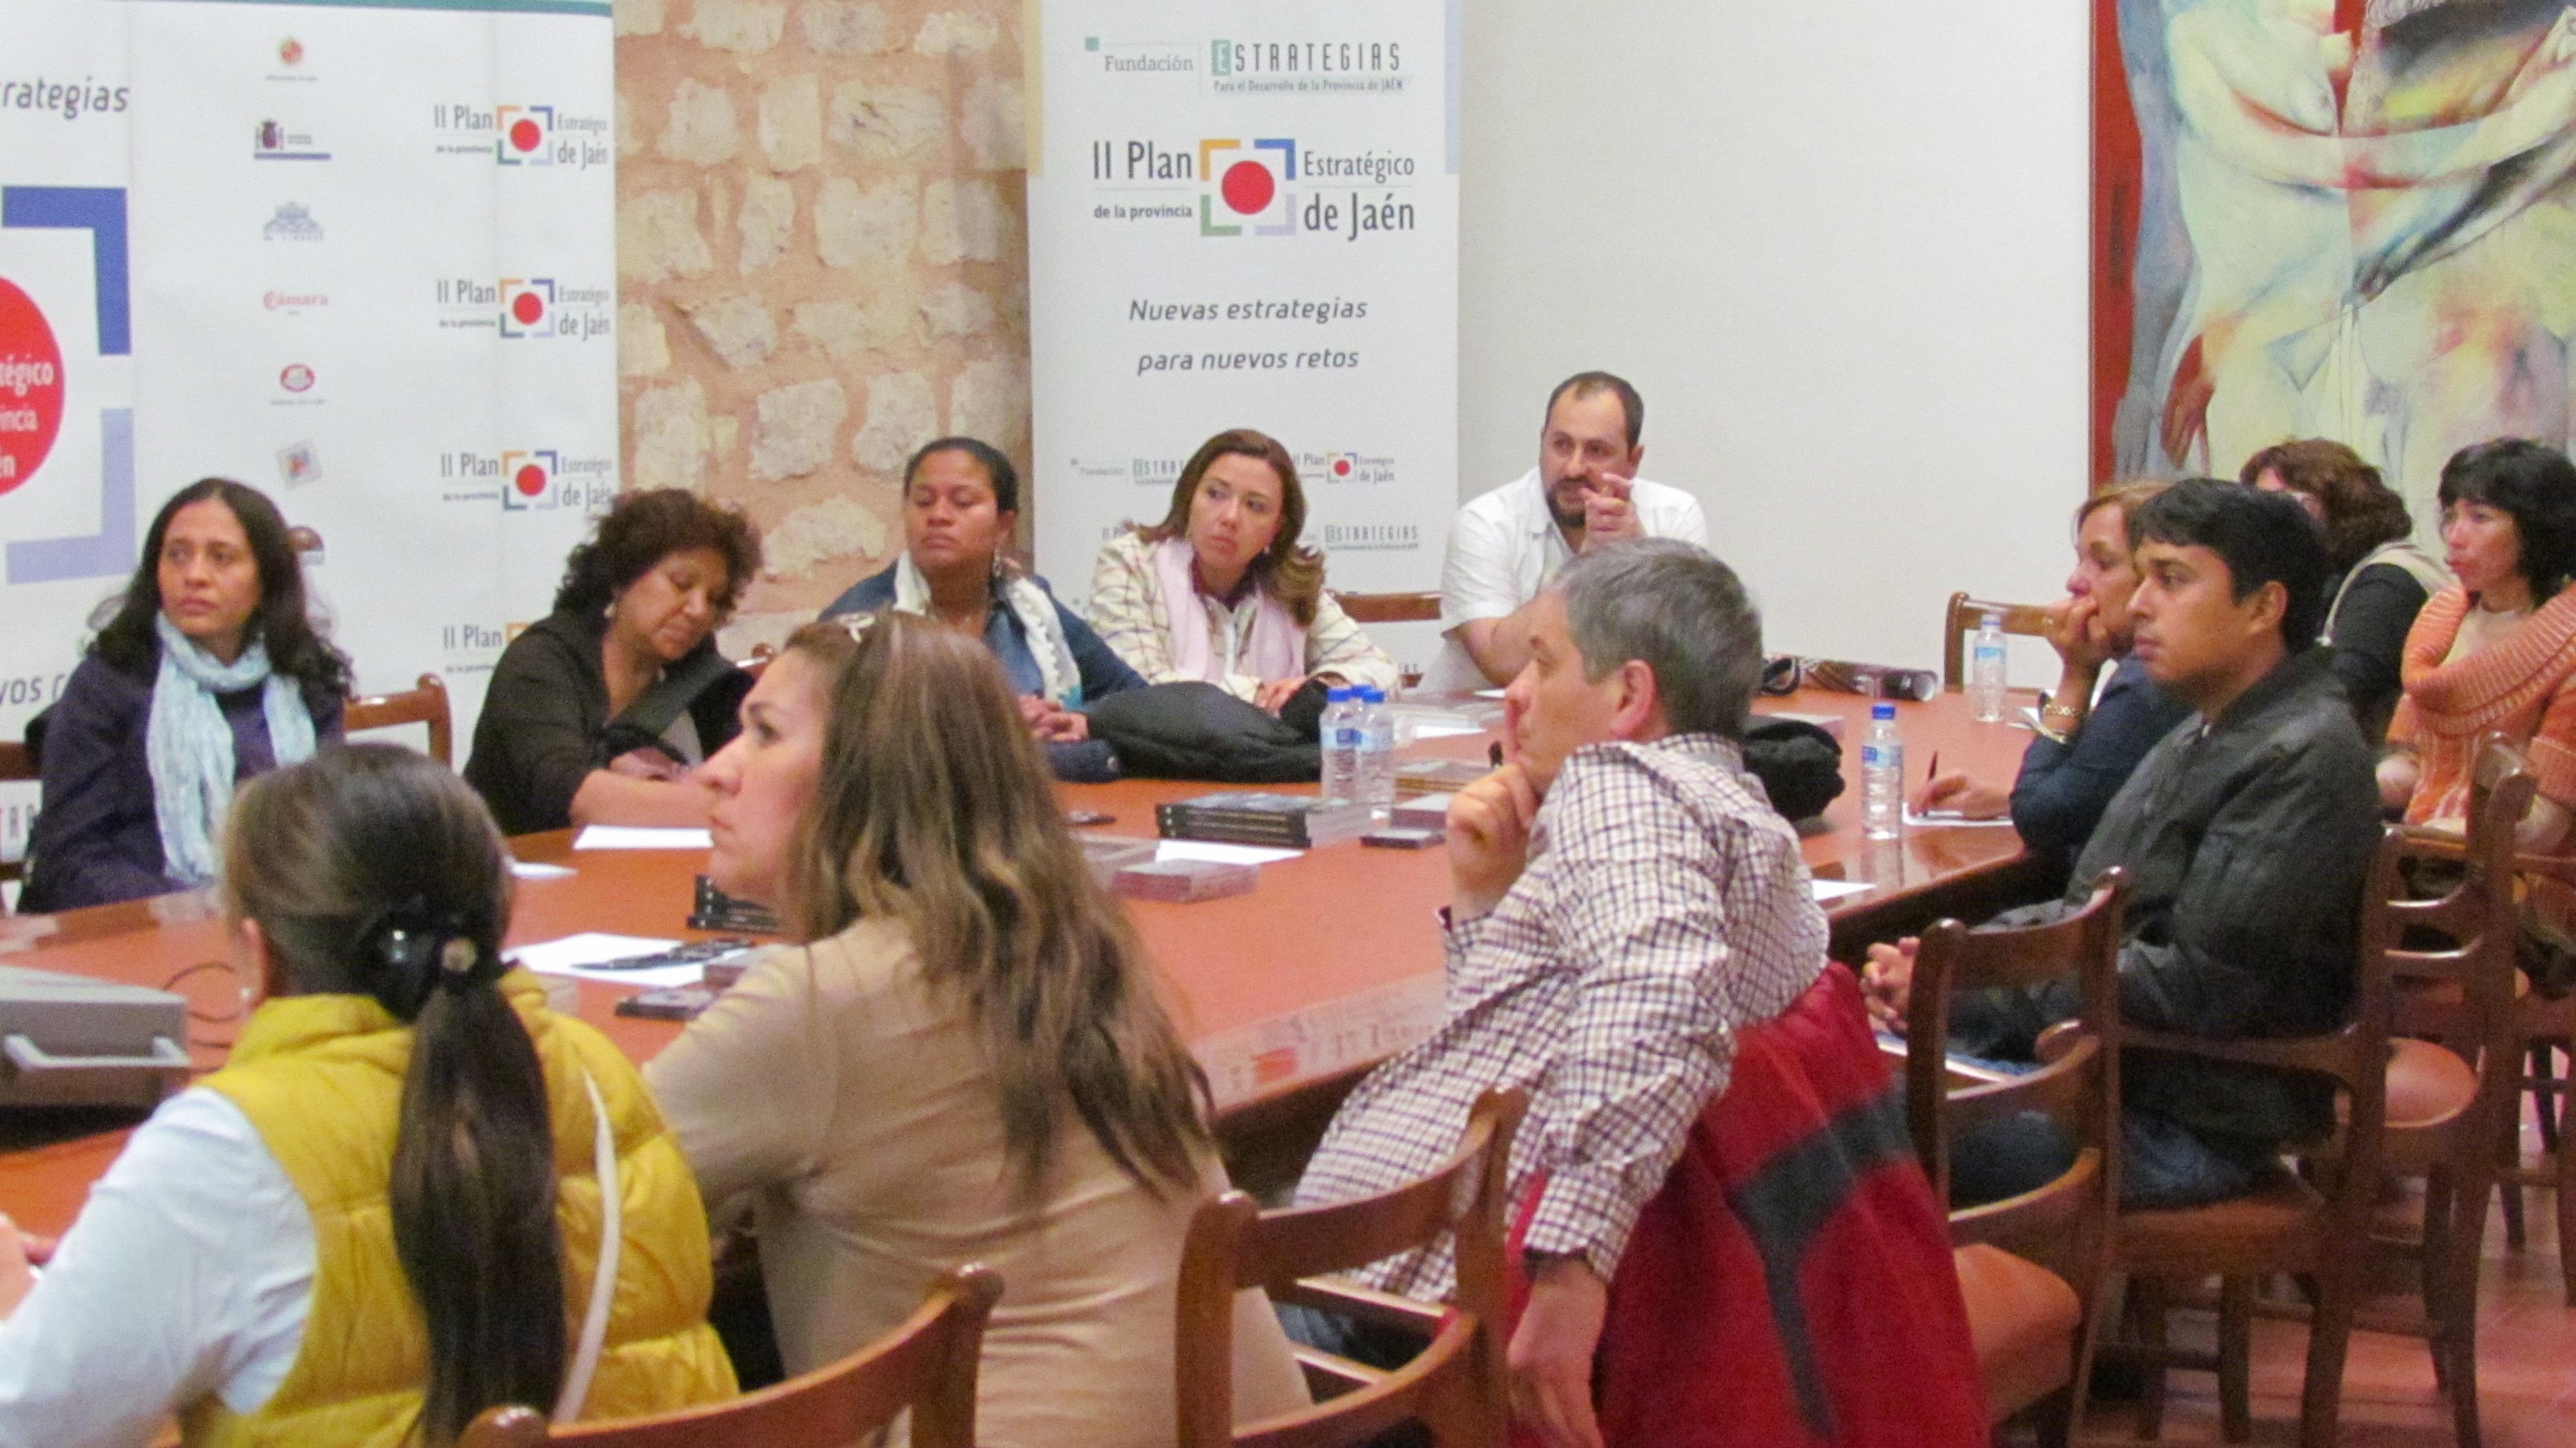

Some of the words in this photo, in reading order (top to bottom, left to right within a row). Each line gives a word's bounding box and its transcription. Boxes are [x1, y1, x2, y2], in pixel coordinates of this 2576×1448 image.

[1105, 55, 1194, 72] Fundación
[1213, 41, 1400, 74] ESTRATEGIAS
[0, 76, 130, 120] rategias
[455, 105, 493, 129] Plan
[1128, 140, 1193, 180] Plan
[1304, 150, 1415, 184] Estratégico
[1094, 205, 1110, 219] de
[1115, 205, 1126, 218] la
[1130, 204, 1193, 222] provincia
[1305, 192, 1338, 231] de
[1347, 191, 1415, 242] Jaén
[457, 279, 495, 303] Plan
[1130, 299, 1219, 321] Nuevas
[1227, 297, 1368, 323] estrategias
[1137, 354, 1194, 376] para
[1201, 352, 1288, 370] nuevos
[1296, 348, 1359, 368] retos
[460, 453, 499, 477] Plan
[464, 625, 502, 648] Plan
